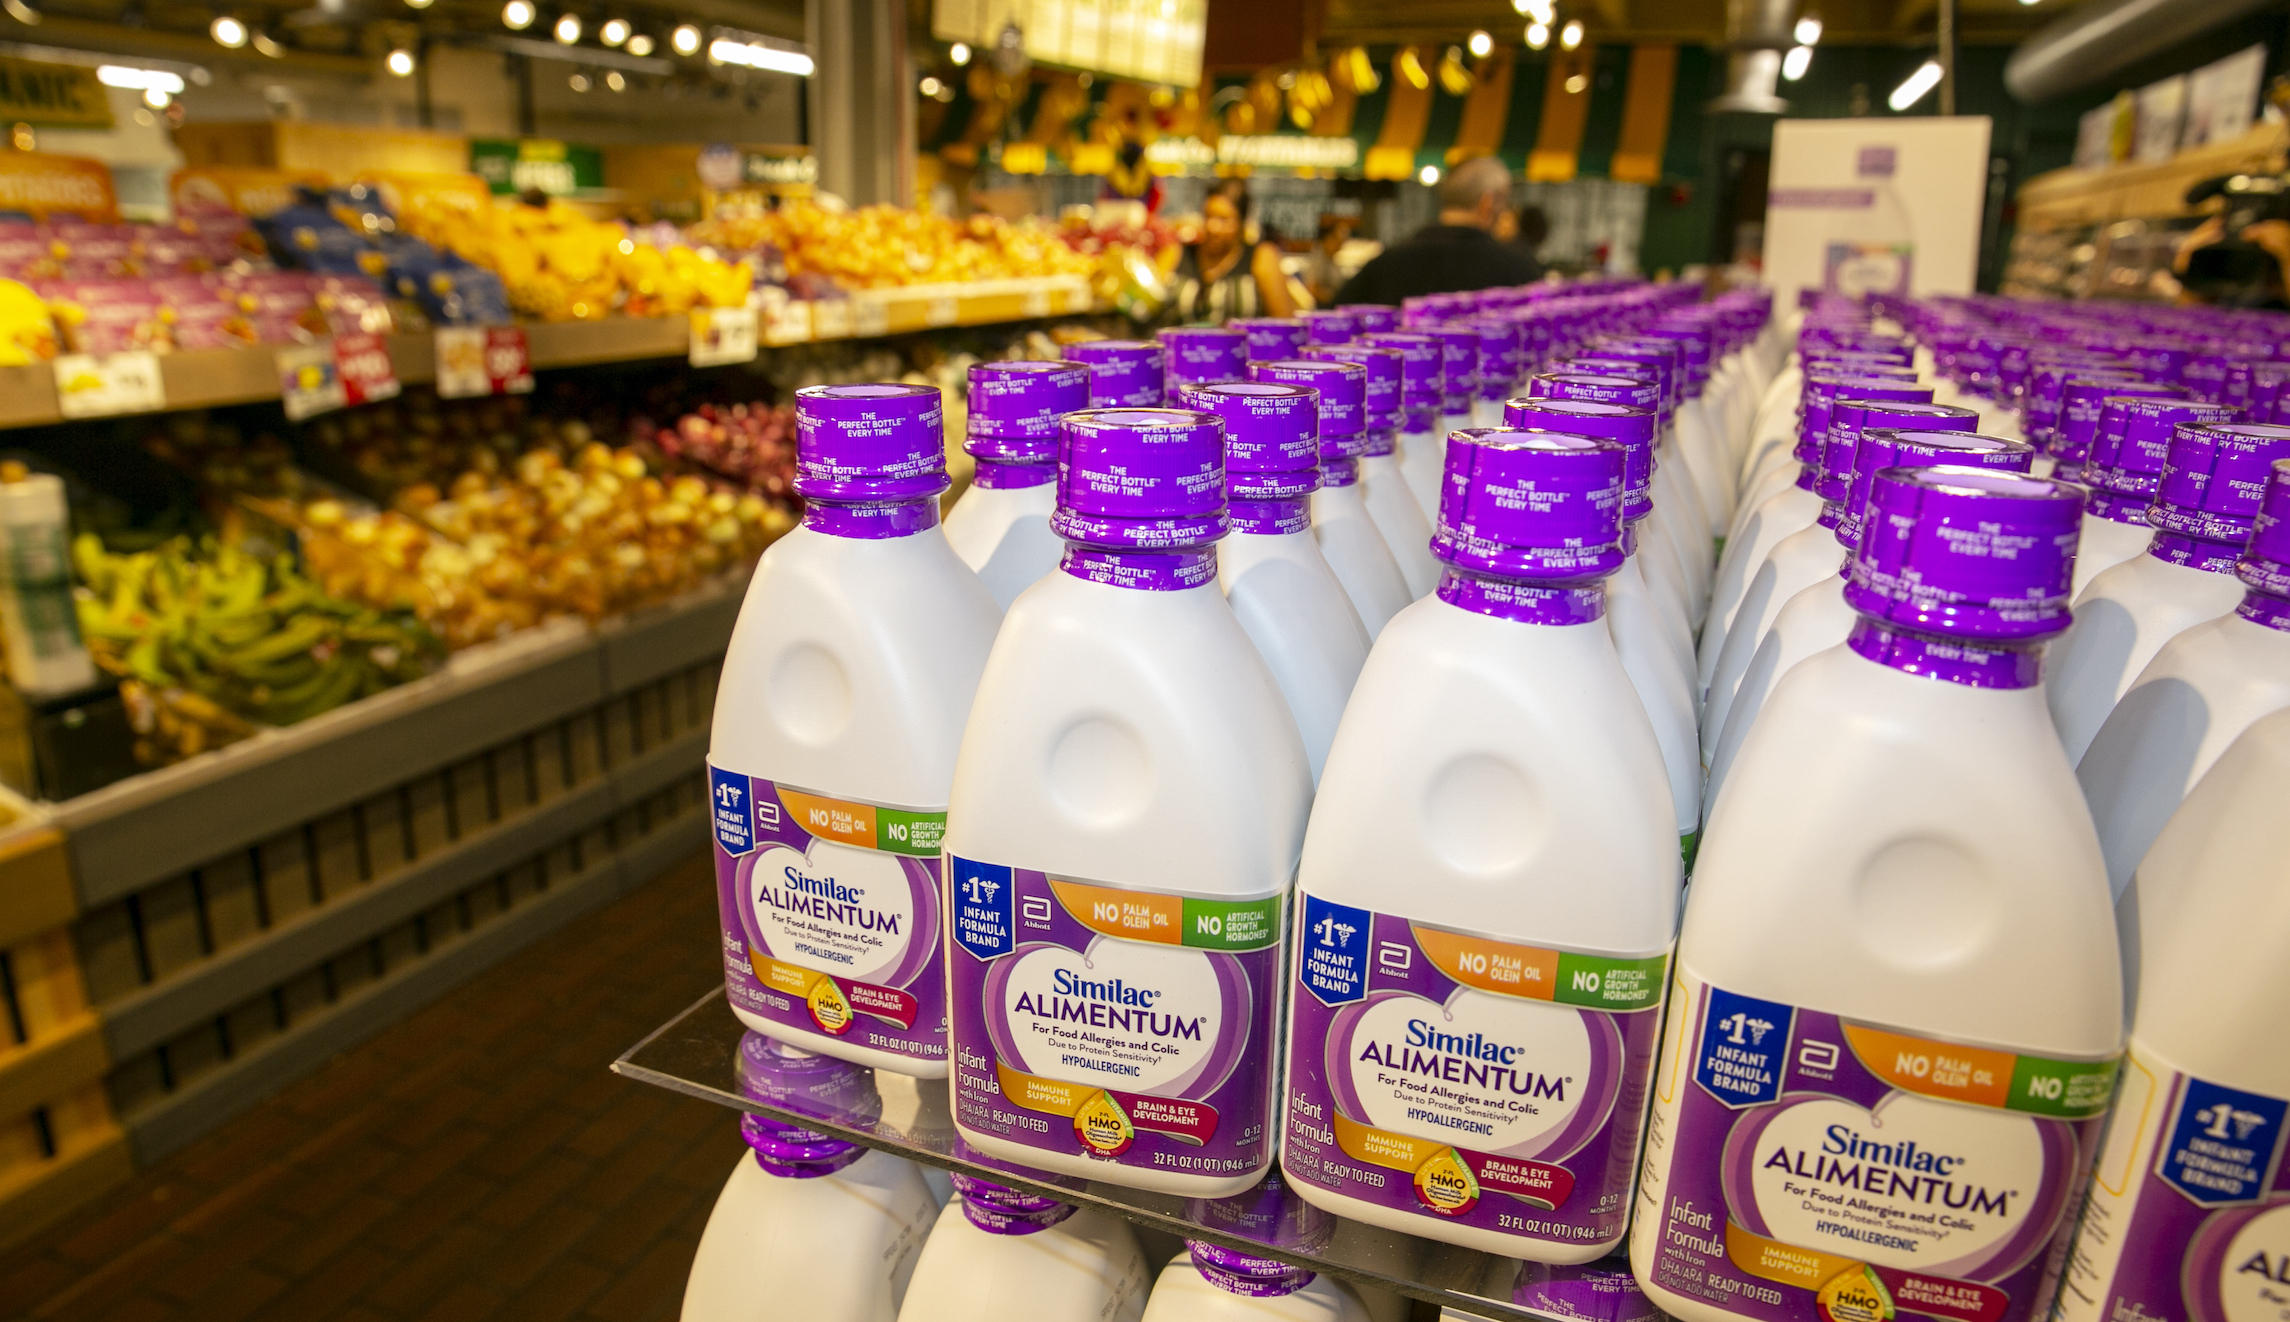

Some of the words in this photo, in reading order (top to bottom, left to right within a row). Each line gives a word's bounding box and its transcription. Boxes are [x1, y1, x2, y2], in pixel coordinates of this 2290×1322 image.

[861, 412, 876, 420] THE
[1251, 407, 1272, 415] EVERY
[838, 420, 871, 429] PERFECT
[875, 428, 892, 436] TIME
[1142, 433, 1167, 444] EVERY
[1169, 433, 1189, 442] TIME
[2177, 430, 2194, 442] EVERY
[2194, 435, 2212, 445] TIME
[1983, 454, 2007, 464] EVERY
[1081, 470, 1119, 486] PERFECT
[1109, 465, 1127, 475] THE
[1090, 482, 1118, 495] EVERY
[1120, 485, 1143, 496] TIME
[1485, 484, 1526, 500] PERFECT
[1517, 479, 1536, 490] THE
[1495, 497, 1528, 510] EVERY
[1529, 502, 1551, 512] TIME
[1123, 529, 1169, 539] PERFECT
[1156, 521, 1175, 529] THE
[1136, 539, 1172, 547] EVERY
[1173, 537, 1195, 546] TIME
[716, 783, 730, 807] #1
[718, 809, 744, 824] INFANT
[810, 808, 828, 827] NO
[832, 810, 852, 823] PALM
[854, 820, 866, 832] OIL
[716, 819, 749, 837] FORMULA
[832, 821, 852, 834] OLEIN
[888, 823, 907, 841] NO
[911, 822, 945, 830] ARTIFICIAL
[911, 831, 939, 839] GROWTH
[720, 831, 745, 846] BRAND
[962, 876, 982, 904] #1
[964, 906, 1000, 923] INFANT
[1094, 901, 1119, 923] NO
[1123, 902, 1150, 917] PALM
[1153, 913, 1169, 926] OIL
[1123, 915, 1150, 929] OLEIN
[772, 913, 784, 924] For
[787, 917, 805, 929] Food
[808, 923, 841, 938] Allergies
[844, 933, 858, 942] and
[861, 935, 882, 946] Colic
[960, 917, 1006, 937] FORMULA
[1024, 920, 1051, 931] Abbott
[1197, 915, 1221, 935] NO
[1226, 911, 1264, 922] ARTIFICIAL
[1226, 922, 1258, 932] GROWTH
[966, 931, 999, 948] BRAND
[1314, 918, 1334, 947] #1
[795, 942, 854, 965] HYPOALLERGENIC
[1313, 948, 1354, 968] INFANT
[772, 965, 803, 979] IMMUNE
[1308, 959, 1358, 983] FORMULA
[1379, 967, 1409, 979] Abbott
[1459, 952, 1487, 974] NO
[1491, 955, 1521, 971] PALM
[1524, 966, 1541, 981] OIL
[1490, 968, 1520, 983] OLEIN
[771, 973, 805, 987] SUPPORT
[1312, 974, 1350, 994] BRAND
[1572, 971, 1600, 993] NO
[749, 989, 767, 1003] READY
[767, 995, 775, 1006] TO
[775, 997, 790, 1011] FEED
[851, 994, 903, 1011] DEVELOPMENT
[853, 986, 876, 998] BRAIN
[885, 993, 899, 1003] EYE
[818, 998, 842, 1012] HMO
[1718, 1012, 1747, 1044] #1
[1032, 1023, 1049, 1035] For
[1052, 1026, 1077, 1039] Food
[1080, 1032, 1125, 1049] Allergies
[1129, 1041, 1148, 1051] and
[1151, 1043, 1179, 1055] Colic
[1048, 1038, 1066, 1049] Due
[1068, 1043, 1077, 1051] to
[1079, 1045, 1110, 1057] Protein
[957, 1042, 987, 1071] Infant
[1062, 1054, 1140, 1077] HYPOALLERGENIC
[1716, 1045, 1768, 1068] INFANT
[958, 1064, 1000, 1095] Formula
[1707, 1057, 1771, 1084] FORMULA
[1028, 1081, 1070, 1098] IMMUNE
[1712, 1074, 1760, 1096] BRAND
[959, 1088, 973, 1100] with
[974, 1091, 988, 1104] Iron
[1026, 1090, 1072, 1106] SUPPORT
[1291, 1087, 1322, 1121] Infant
[1137, 1101, 1167, 1113] BRAIN
[1169, 1105, 1176, 1114] &
[1178, 1107, 1196, 1116] EYE
[993, 1110, 1018, 1126] READY
[1018, 1116, 1028, 1128] TO
[1030, 1118, 1048, 1133] FEED
[1088, 1116, 1121, 1131] HMO
[1133, 1110, 1199, 1126] DEVELOPMENT
[1407, 1107, 1493, 1136] HYPOALLERGENIC
[1290, 1109, 1334, 1146] Formula
[1153, 1152, 1165, 1165] 32
[1167, 1155, 1178, 1167] FL
[1179, 1156, 1191, 1168] OZ
[1193, 1157, 1202, 1170] (1
[1203, 1158, 1221, 1171] QT)
[1222, 1159, 1243, 1172] (946
[1486, 1161, 1519, 1175] BRAIN
[1521, 1168, 1529, 1176] &
[1531, 1168, 1550, 1180] EYE
[1324, 1161, 1350, 1178] READY
[1352, 1170, 1362, 1182] TO
[1364, 1172, 1384, 1188] FEED
[1481, 1169, 1553, 1189] DEVELOPMENT
[1206, 1199, 1237, 1217] PERFECT
[1229, 1202, 1243, 1210] THE
[1670, 1196, 1712, 1231] Infant
[1213, 1209, 1238, 1223] EVERY
[1239, 1219, 1256, 1228] TIME
[1666, 1219, 1724, 1258] Formula
[1816, 1221, 1919, 1252] HYPOALLERGENIC
[1763, 1246, 1820, 1268] IMMUNE
[1760, 1256, 1820, 1278] SUPPORT
[1708, 1274, 1741, 1294] READY
[1742, 1283, 1756, 1298] TO
[1756, 1289, 1782, 1306] FEED
